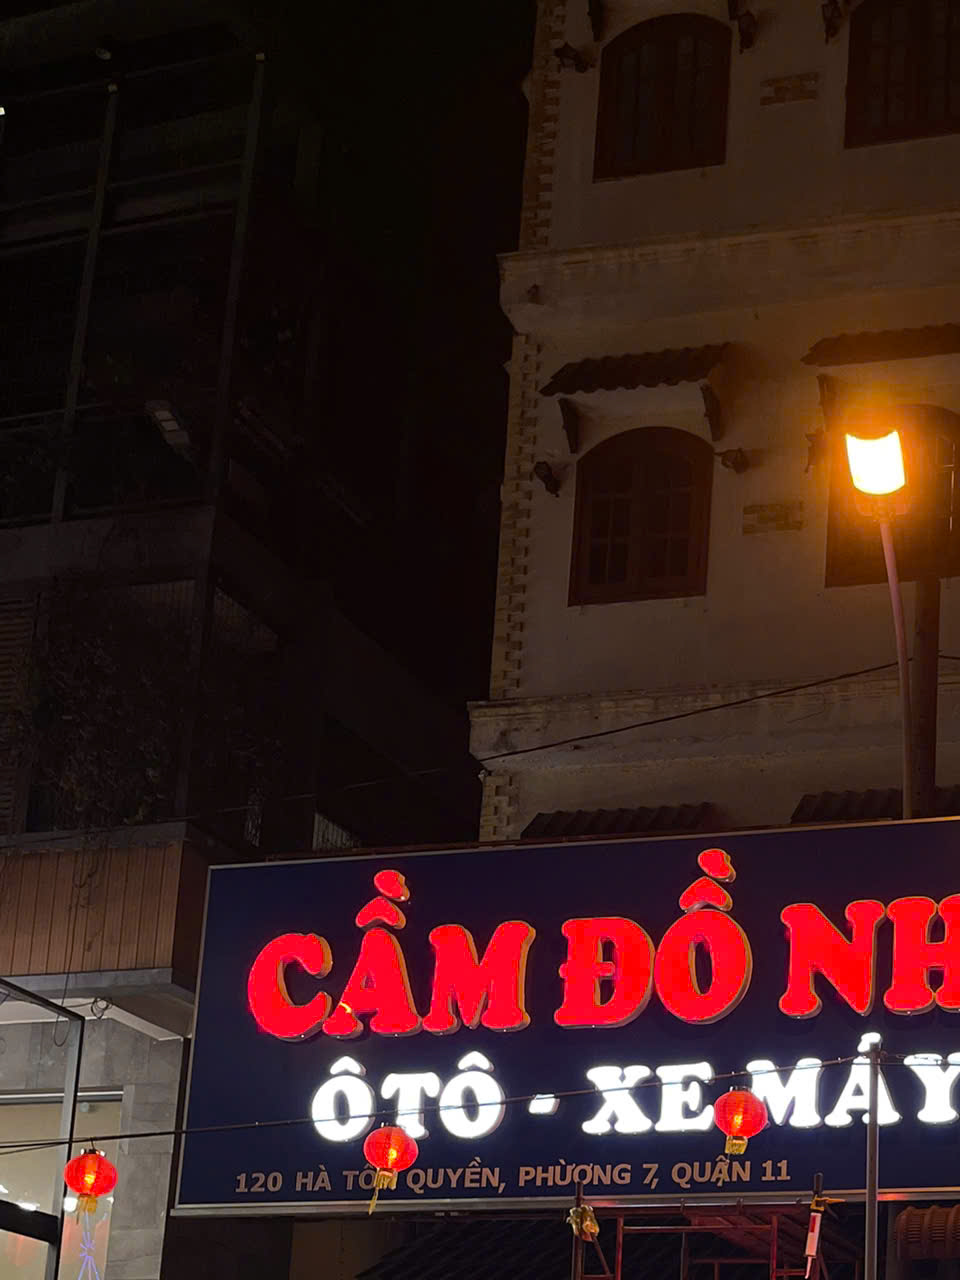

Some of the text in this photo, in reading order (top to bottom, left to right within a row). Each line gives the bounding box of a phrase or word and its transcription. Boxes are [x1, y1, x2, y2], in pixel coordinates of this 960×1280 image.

[247, 868, 535, 1039] CẦM
[553, 848, 753, 1028] ĐỒ
[581, 1060, 716, 1136] XE
[235, 1171, 284, 1193] 120
[295, 1164, 332, 1192] HÀ
[405, 1156, 507, 1195] QUYỀN,
[642, 1162, 659, 1190] 7,
[760, 1159, 792, 1182] 11
